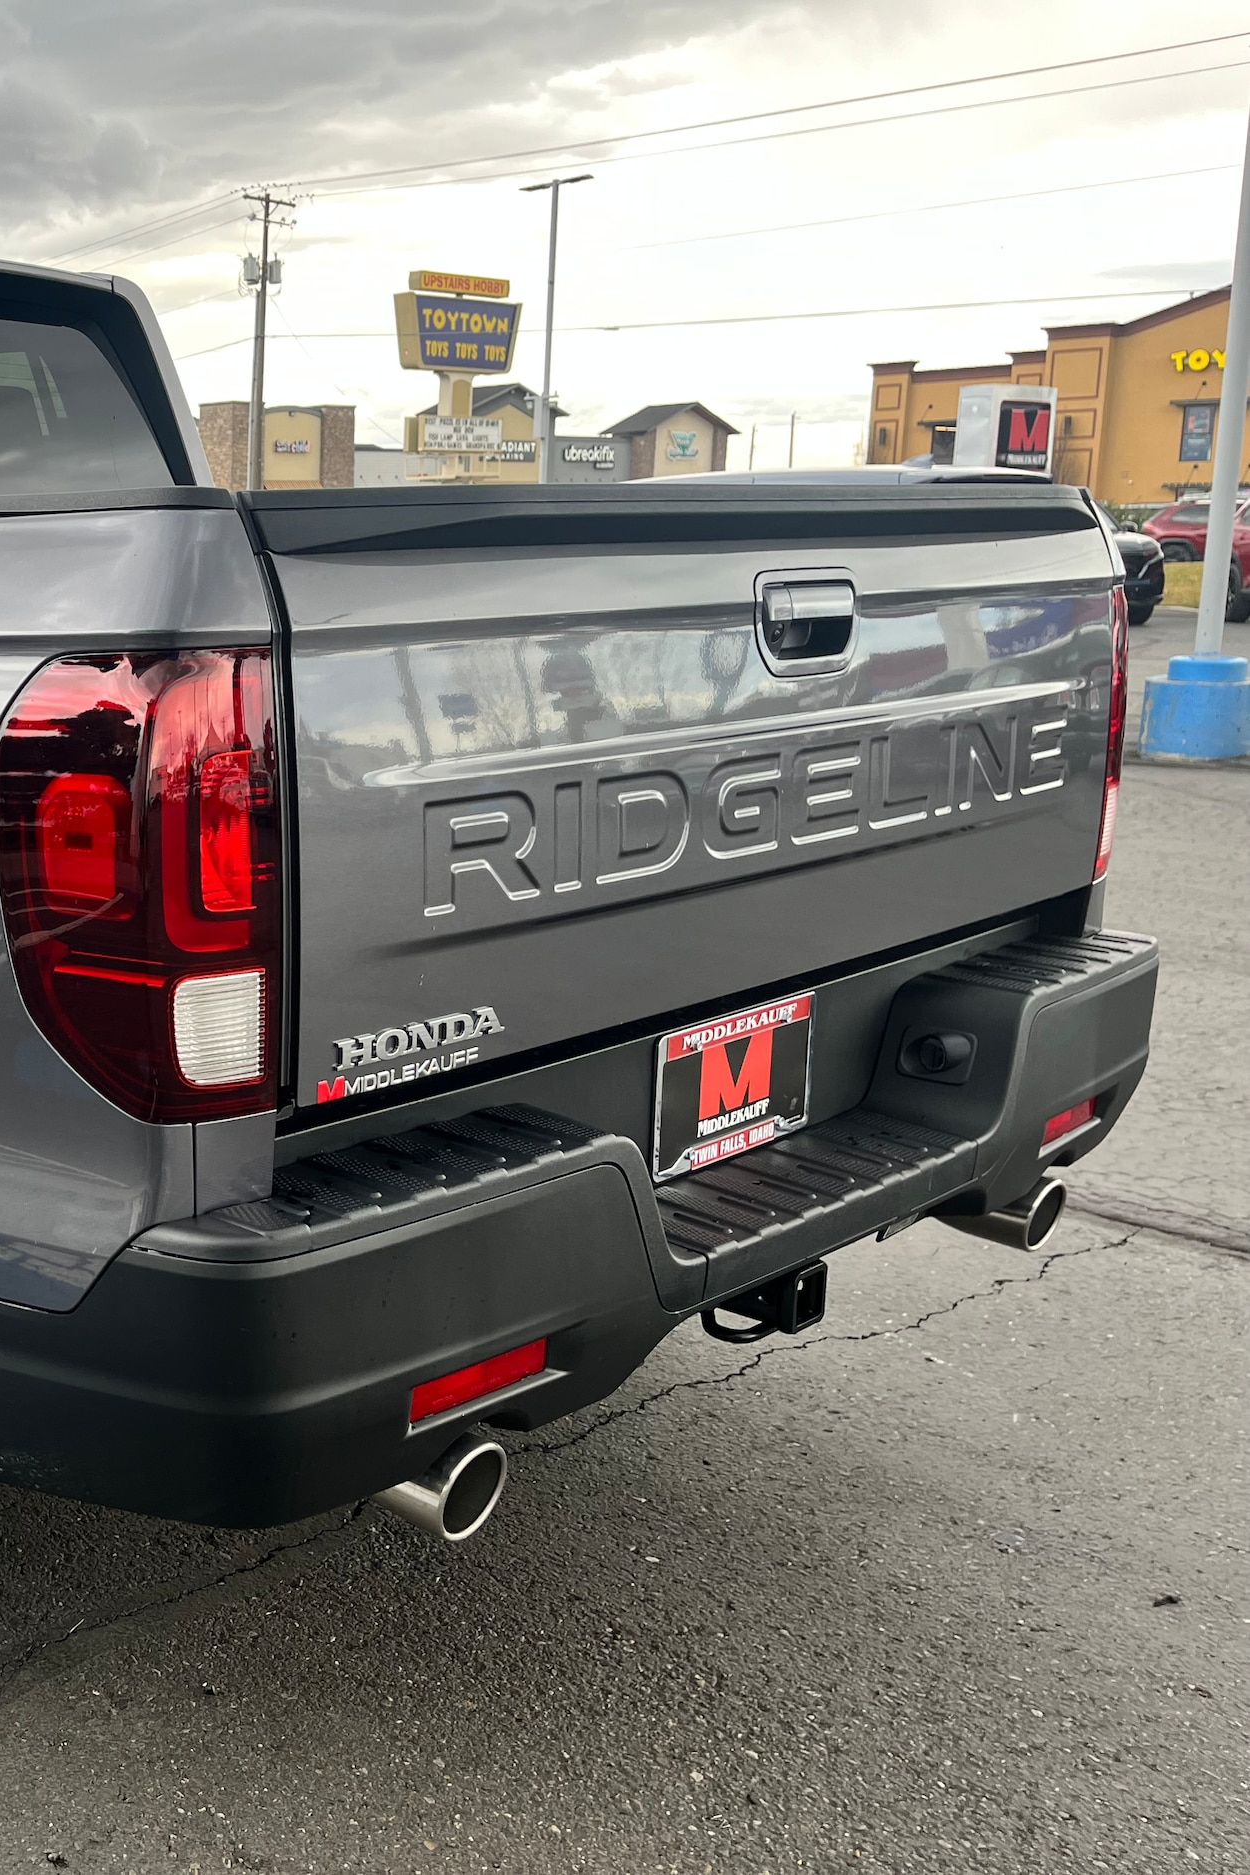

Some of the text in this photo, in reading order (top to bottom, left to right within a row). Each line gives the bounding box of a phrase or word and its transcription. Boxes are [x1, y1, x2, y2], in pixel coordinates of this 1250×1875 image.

[423, 274, 506, 295] UPSTAIRS HOBBY
[422, 308, 509, 336] TOYTOWN
[425, 340, 507, 362] TOYS TOYS TOYS
[501, 441, 536, 453] ADIANT
[422, 716, 1068, 917] RIDGELINE
[332, 1005, 506, 1072] HONDA
[682, 1003, 798, 1051] MIDDLEKAUFF
[344, 1046, 479, 1097] MIDDLEKAUFF
[699, 1028, 774, 1121] M
[696, 1097, 770, 1139] MIDDLEKAUFF
[693, 1121, 775, 1165] TWIN FALLS, IDAHO
